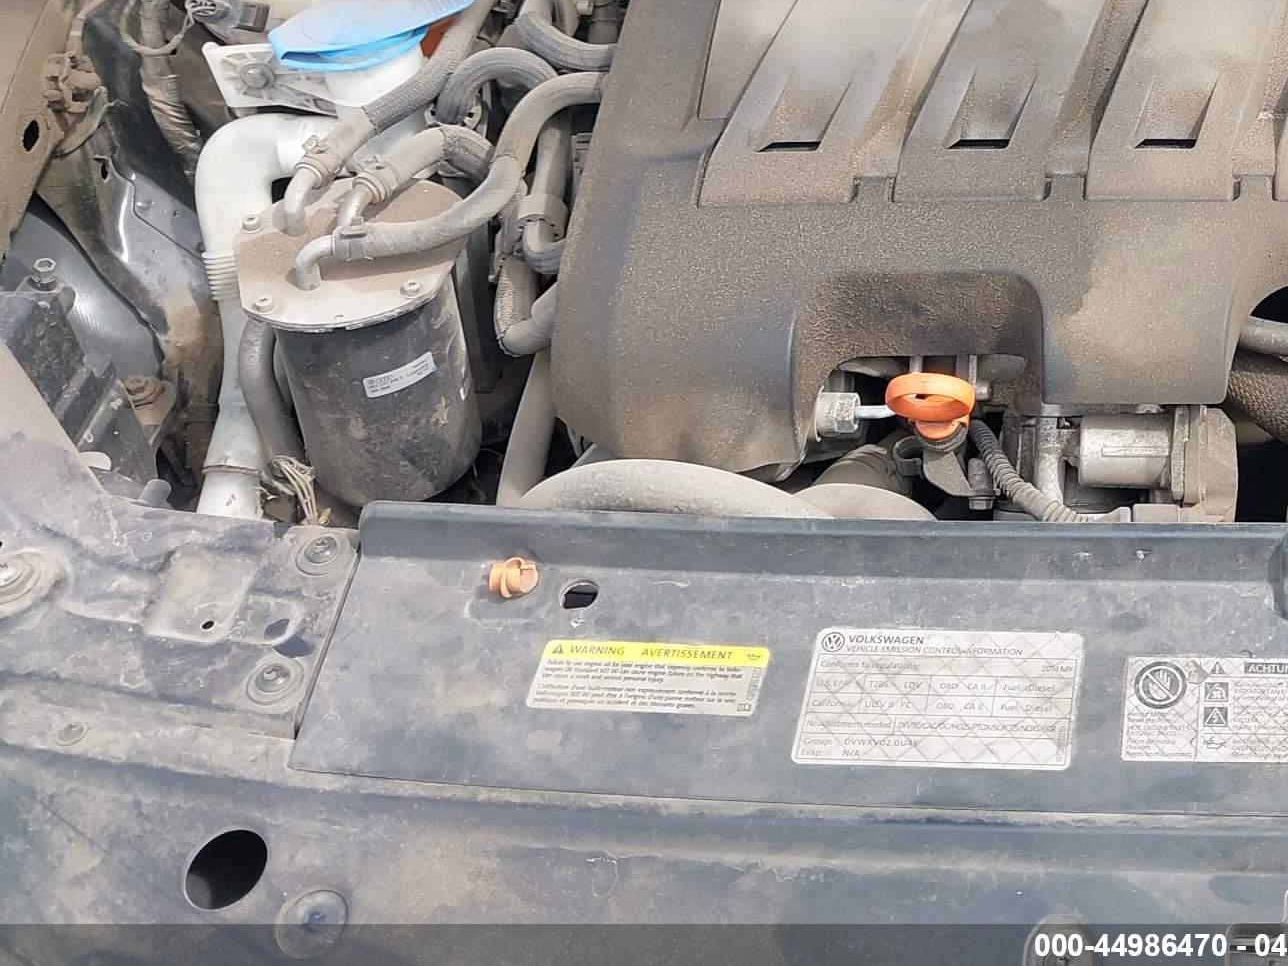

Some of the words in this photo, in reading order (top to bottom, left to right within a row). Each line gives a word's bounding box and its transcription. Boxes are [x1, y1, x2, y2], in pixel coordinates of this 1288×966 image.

[849, 634, 925, 645] VOLKSWAGEN
[569, 644, 626, 656] WARNING
[640, 647, 736, 660] AVERTISSEMENT
[846, 644, 879, 653] VEHICLE
[881, 645, 921, 654] EMISSION
[820, 659, 859, 669] Conforms
[861, 661, 870, 669] to
